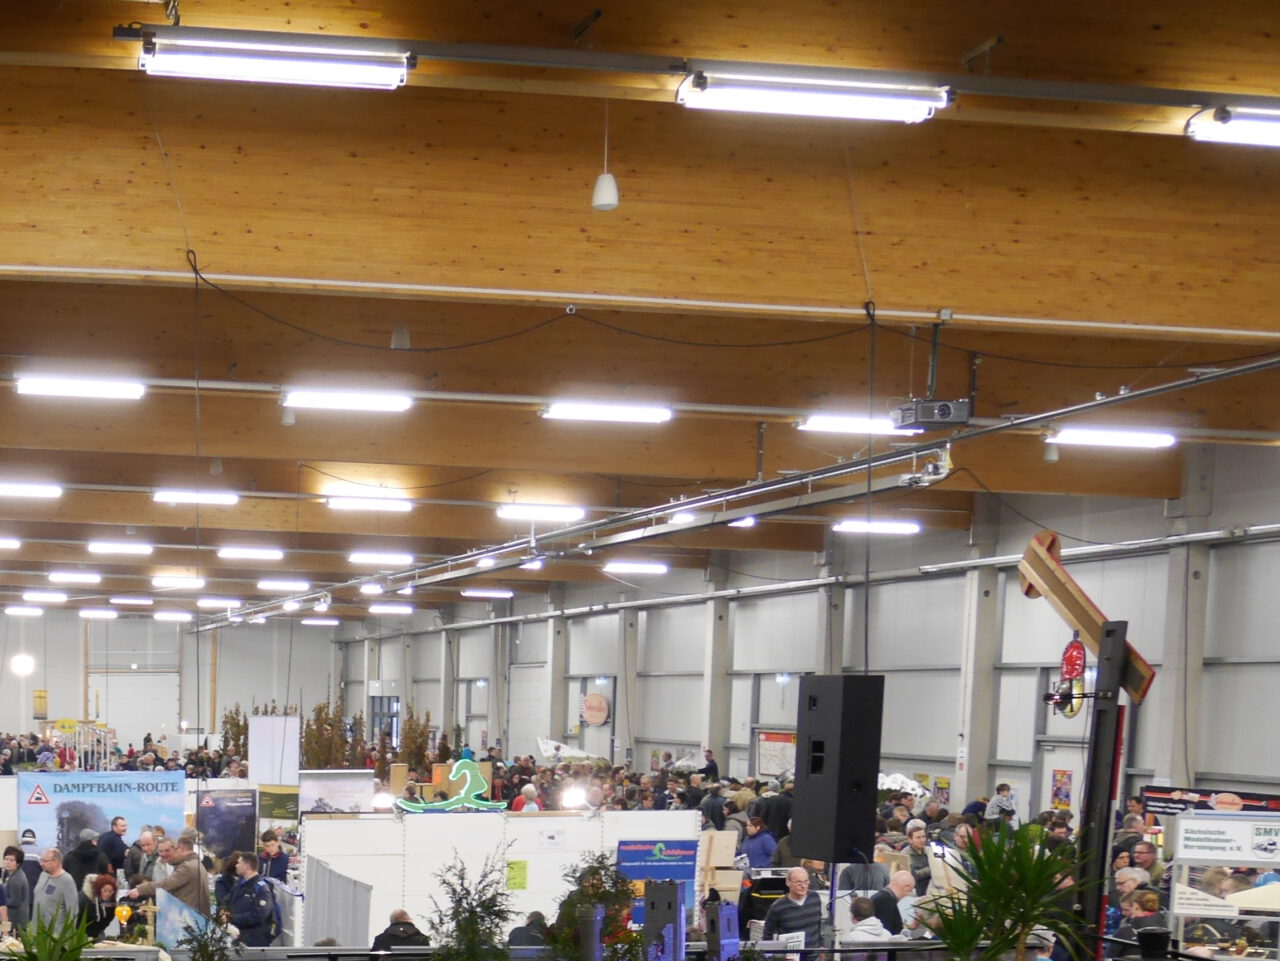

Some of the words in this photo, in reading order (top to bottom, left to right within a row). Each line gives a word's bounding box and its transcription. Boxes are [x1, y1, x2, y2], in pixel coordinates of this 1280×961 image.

[53, 782, 179, 793] DAMPFBAHN-ROUTE
[1184, 828, 1227, 836] Sächsische
[1254, 827, 1280, 837] SMV
